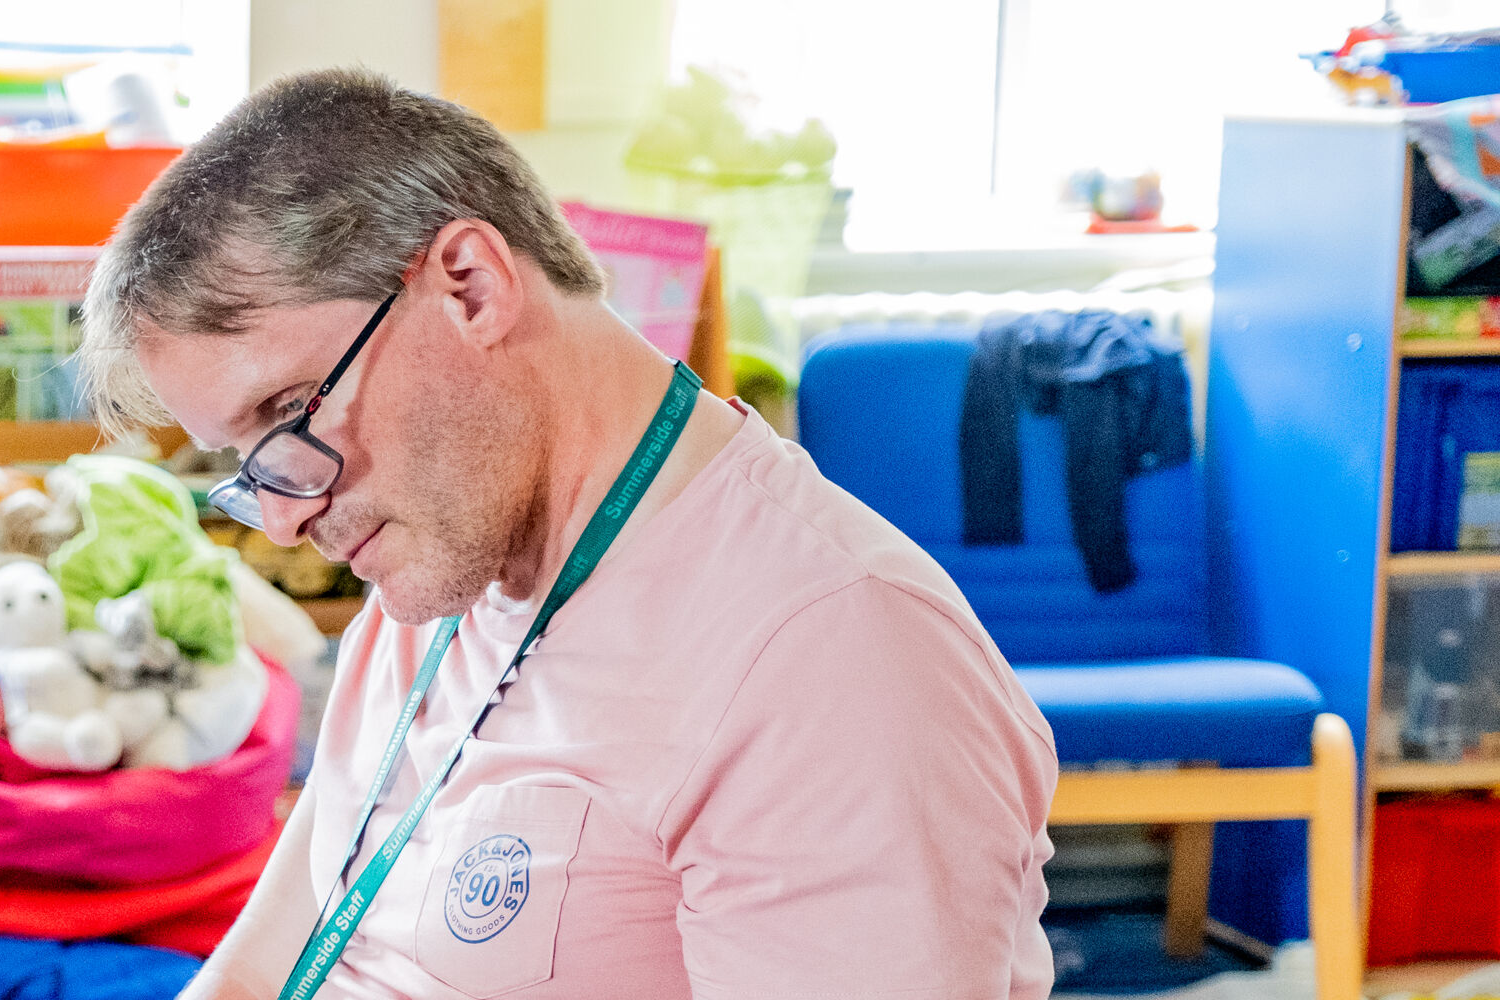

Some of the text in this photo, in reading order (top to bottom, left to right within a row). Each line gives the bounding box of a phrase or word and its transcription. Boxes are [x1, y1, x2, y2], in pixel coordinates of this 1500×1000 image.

[605, 386, 689, 520] Summerside Staff
[382, 763, 449, 861] Summerside
[465, 872, 500, 907] 90
[335, 890, 366, 931] Staff
[476, 914, 506, 935] GOODS
